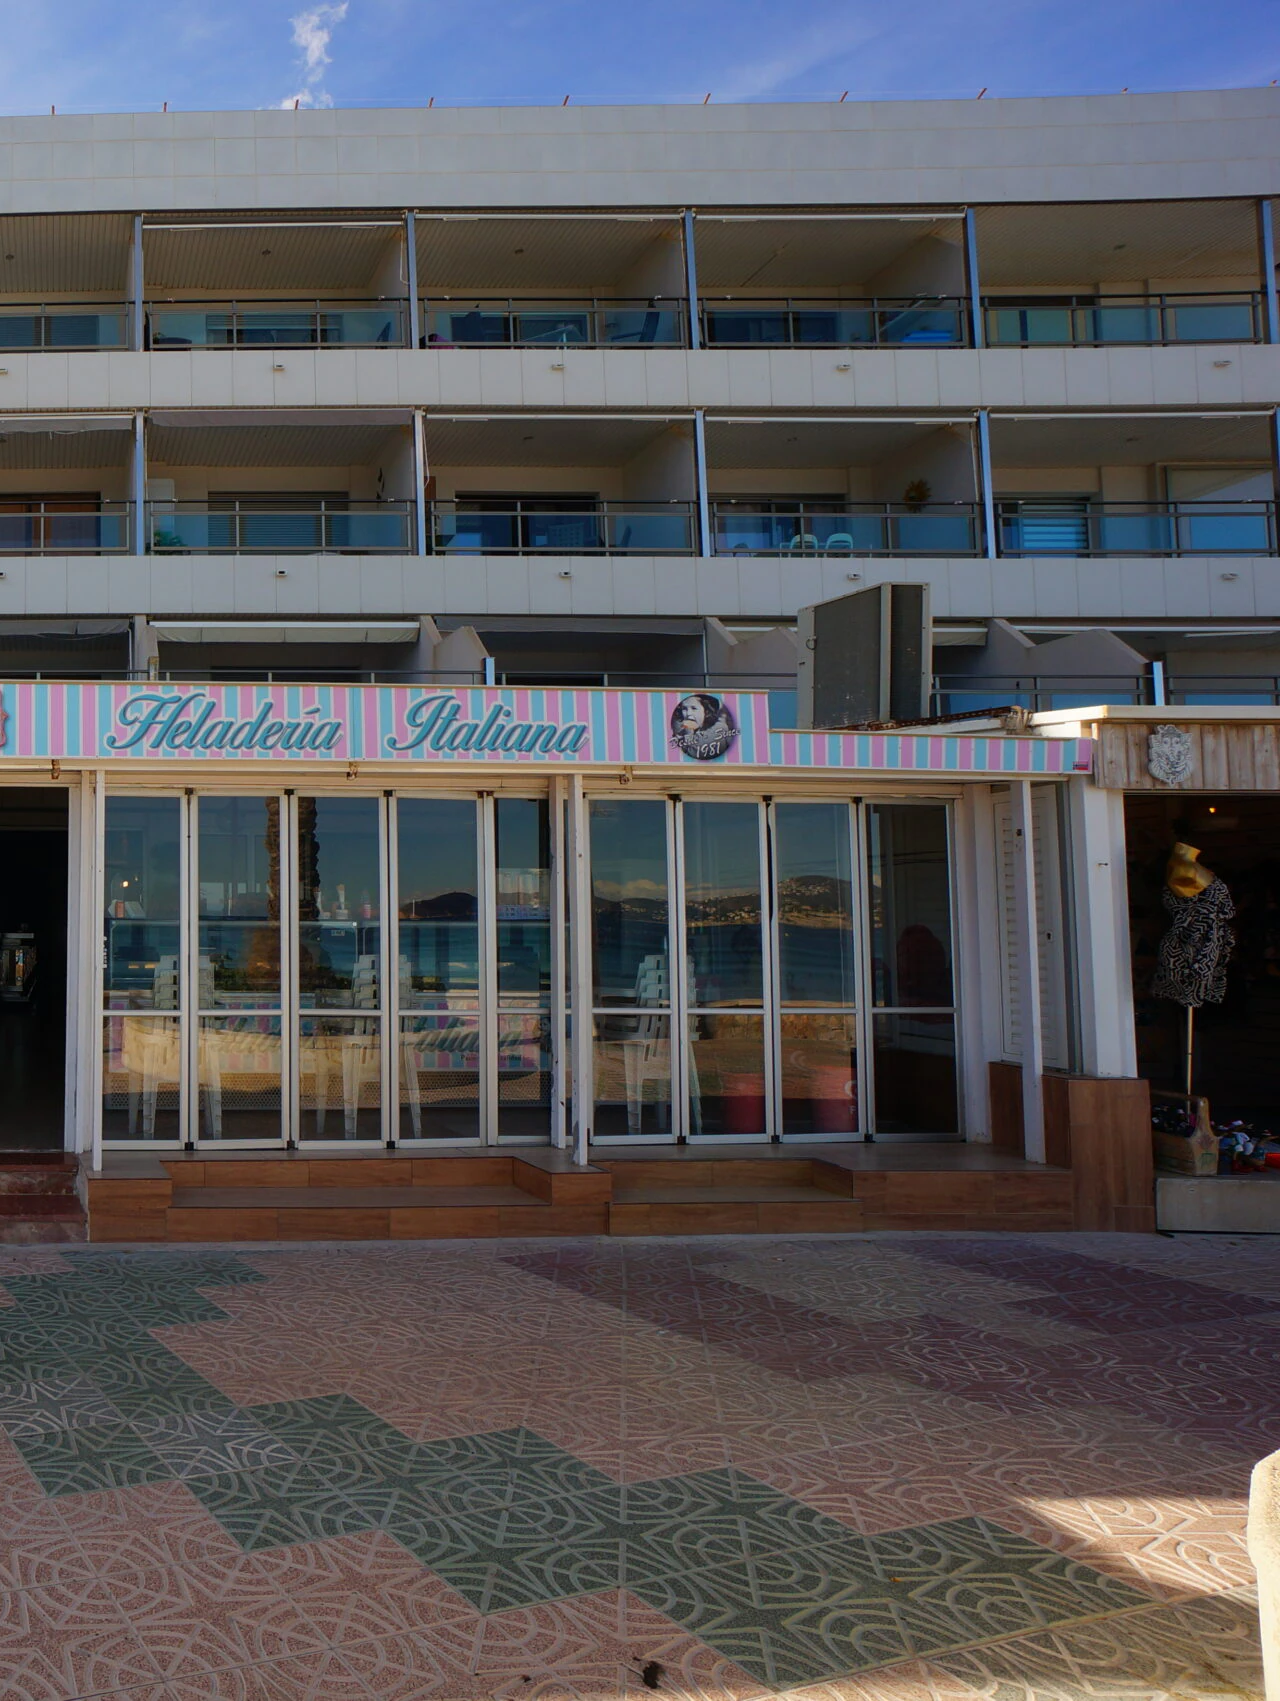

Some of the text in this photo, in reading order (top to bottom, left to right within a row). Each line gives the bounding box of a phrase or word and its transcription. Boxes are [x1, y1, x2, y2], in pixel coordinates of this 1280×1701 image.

[106, 692, 590, 753] Heladería Italiana
[696, 741, 720, 758] 1981
